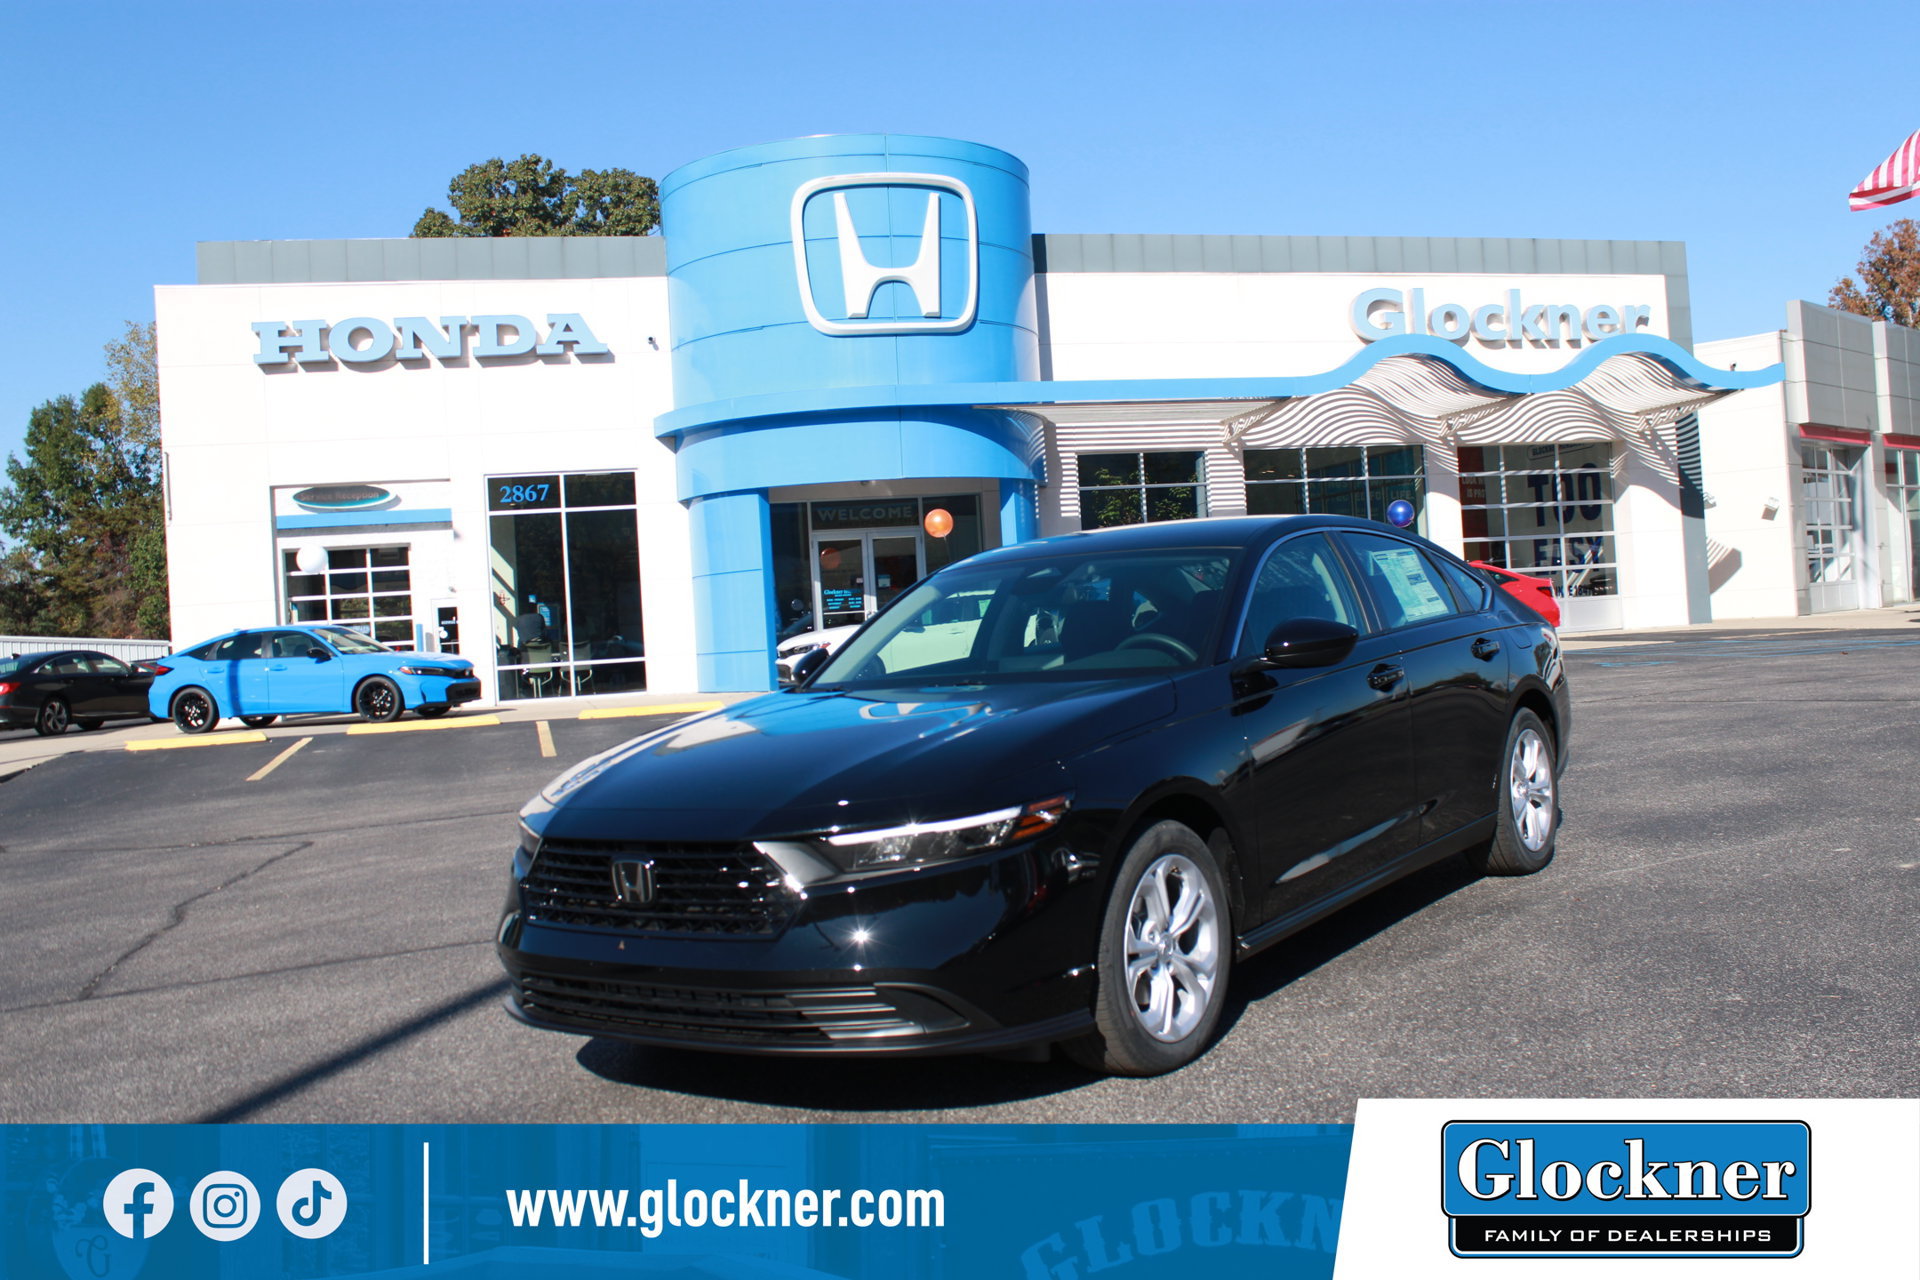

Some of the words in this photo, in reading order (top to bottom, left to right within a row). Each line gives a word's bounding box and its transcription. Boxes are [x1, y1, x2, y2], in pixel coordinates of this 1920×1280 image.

[251, 312, 609, 364] HONDA
[1351, 287, 1651, 341] Glockner
[499, 484, 550, 503] 2867
[816, 505, 913, 521] WELCOME
[1527, 462, 1602, 527] TOO
